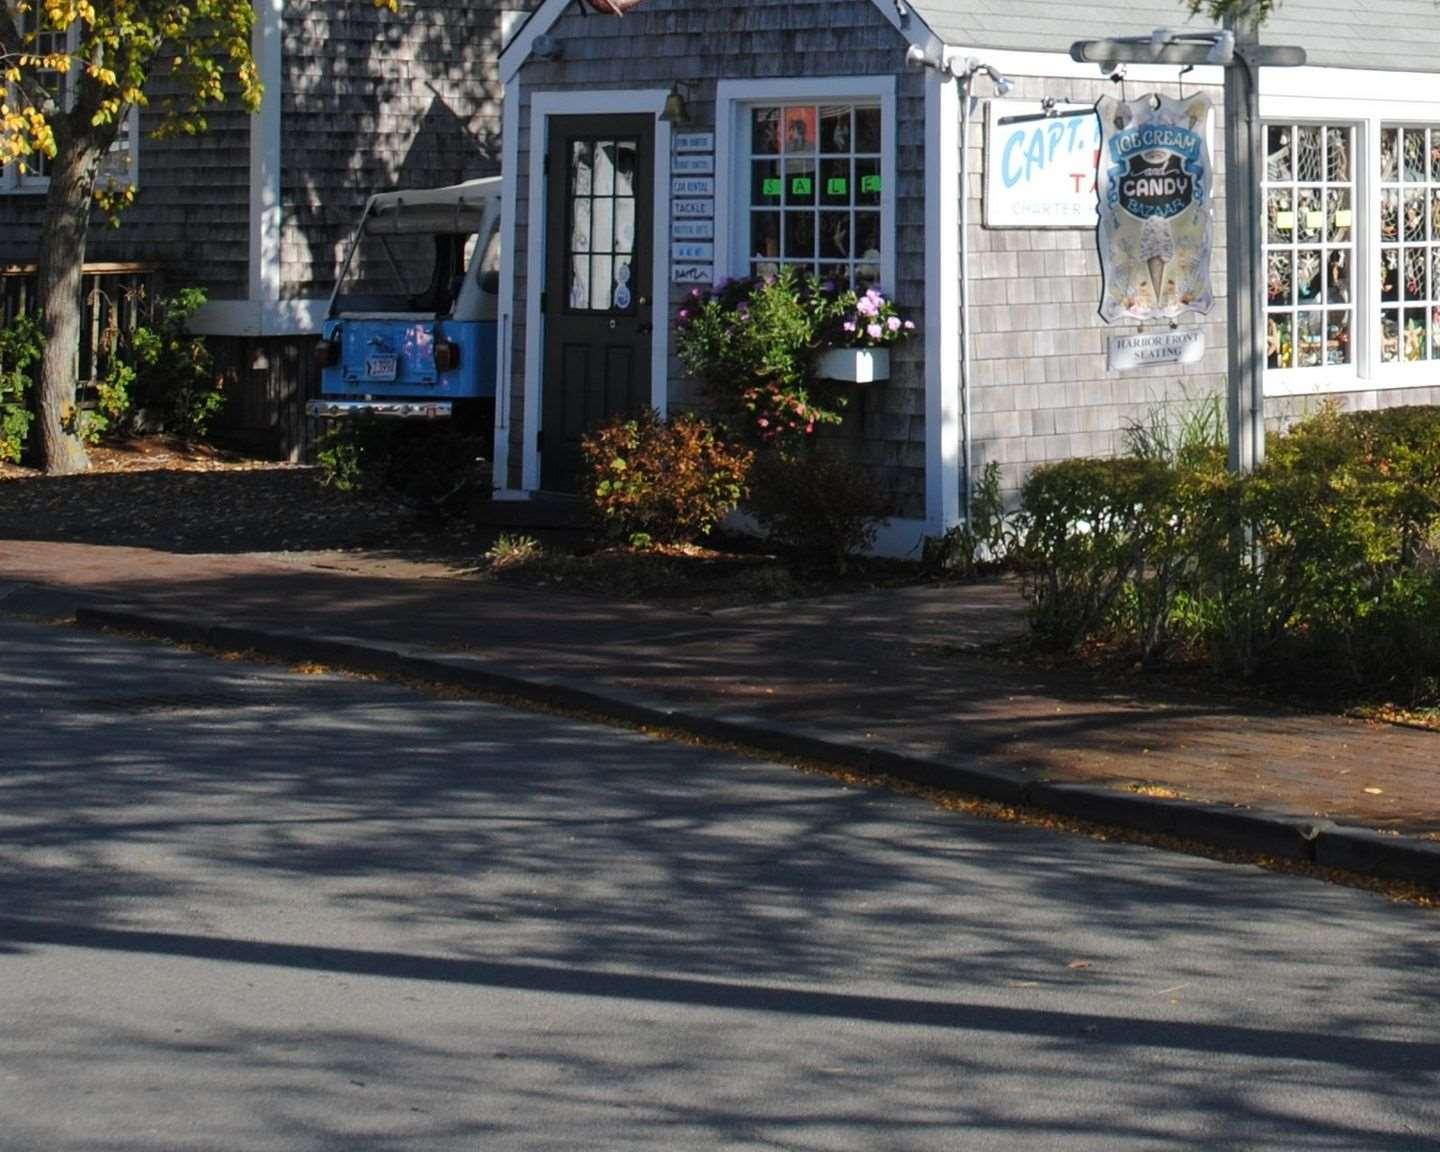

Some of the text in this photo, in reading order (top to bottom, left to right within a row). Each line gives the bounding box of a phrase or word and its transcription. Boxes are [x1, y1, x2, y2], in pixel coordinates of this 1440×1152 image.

[1117, 129, 1196, 155] ICE CREAM
[1002, 117, 1084, 188] CAPT.
[1123, 177, 1188, 197] CANDY
[675, 203, 705, 213] TACKLE
[1128, 198, 1185, 216] BAZAAR
[1117, 332, 1199, 350] HARBOR FRONT
[1135, 347, 1182, 360] SEATING
